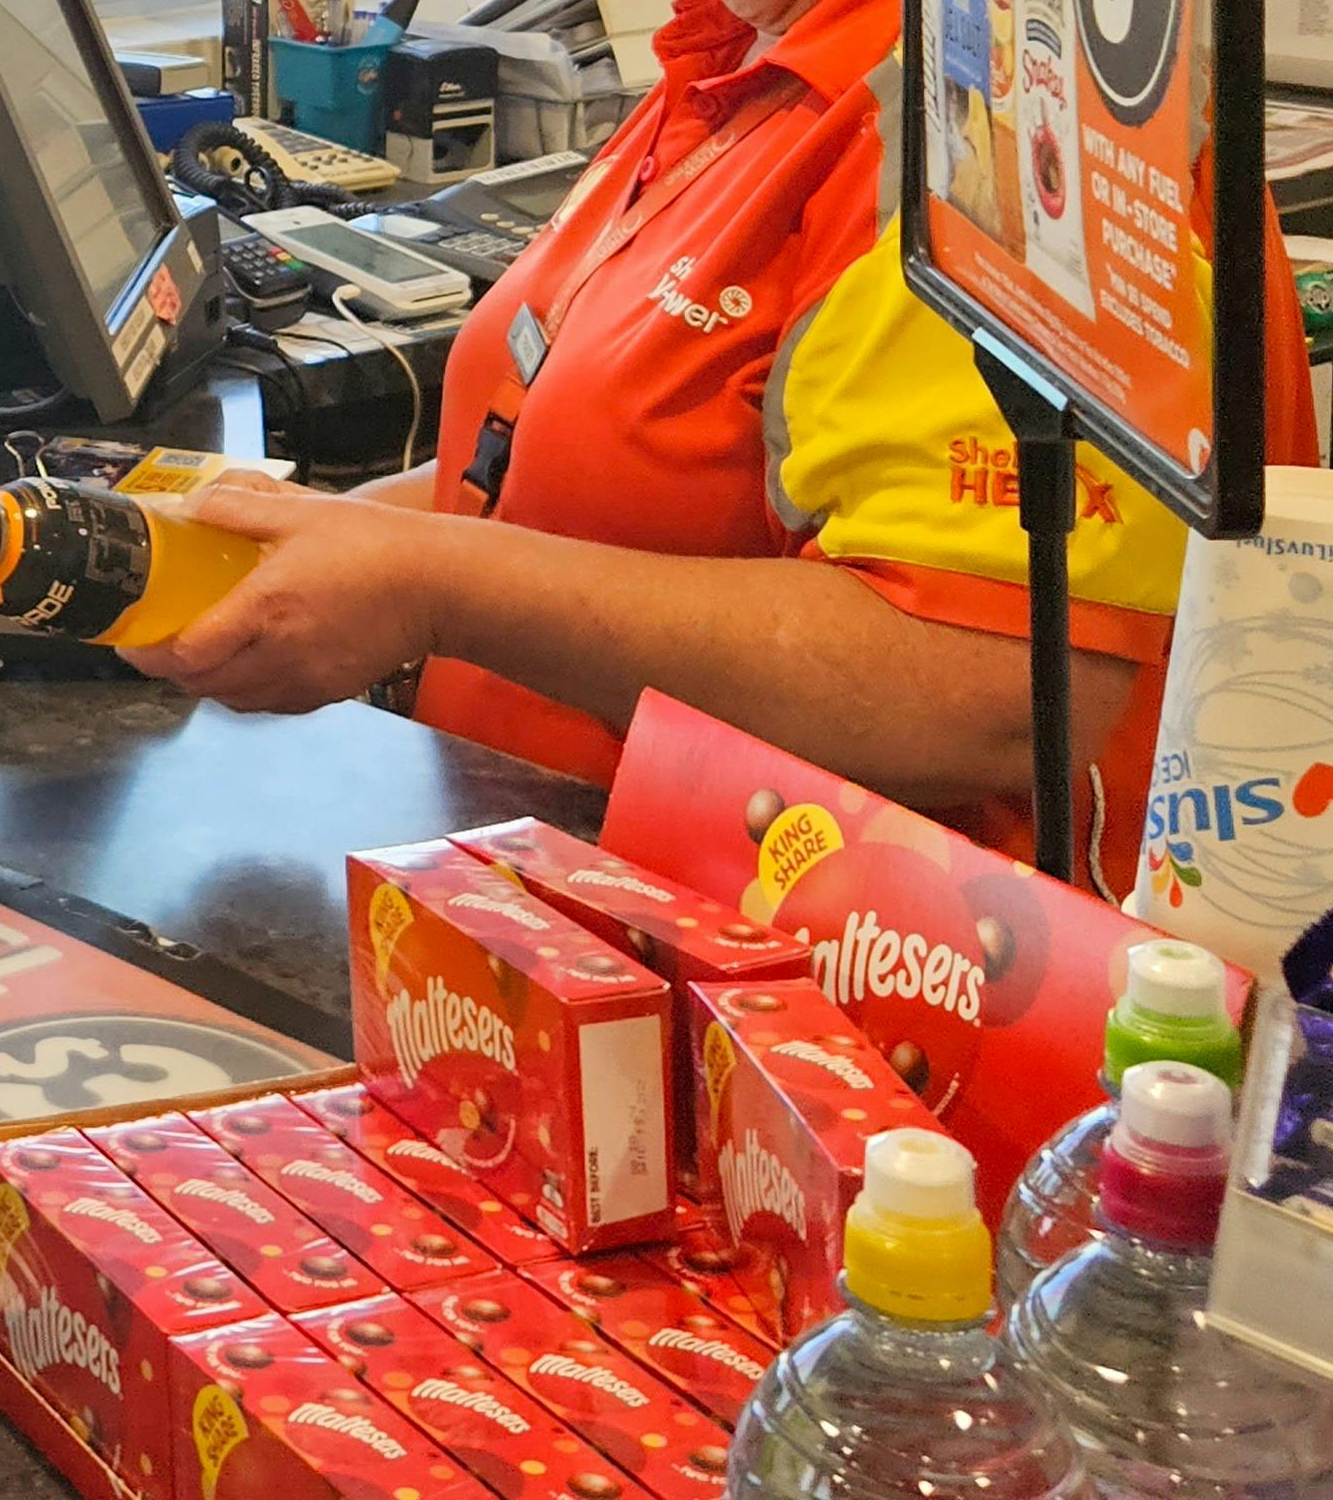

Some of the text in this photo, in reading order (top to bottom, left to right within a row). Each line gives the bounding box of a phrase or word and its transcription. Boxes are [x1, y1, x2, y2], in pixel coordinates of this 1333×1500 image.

[1083, 123, 1183, 214] WITH ANY FUEL
[1091, 171, 1110, 207] OR
[948, 437, 1019, 466] Shel
[951, 467, 1124, 525] HEX
[1161, 750, 1191, 782] ICE
[1146, 777, 1285, 842] slus
[768, 813, 813, 862] KING
[772, 828, 829, 891] SHARE
[567, 868, 676, 903] Maltesers
[796, 909, 984, 1020] altesers
[387, 975, 517, 1089] Maltesers
[770, 1039, 874, 1091] Maltesers
[173, 1177, 275, 1226] Maltesers
[281, 1158, 384, 1204] Maltesers
[63, 1197, 163, 1245] Maltesers
[590, 1197, 601, 1224] BEST
[411, 1378, 530, 1435] Maltesers
[530, 1354, 650, 1408] Maltesers
[287, 1402, 406, 1460] Maltesers
